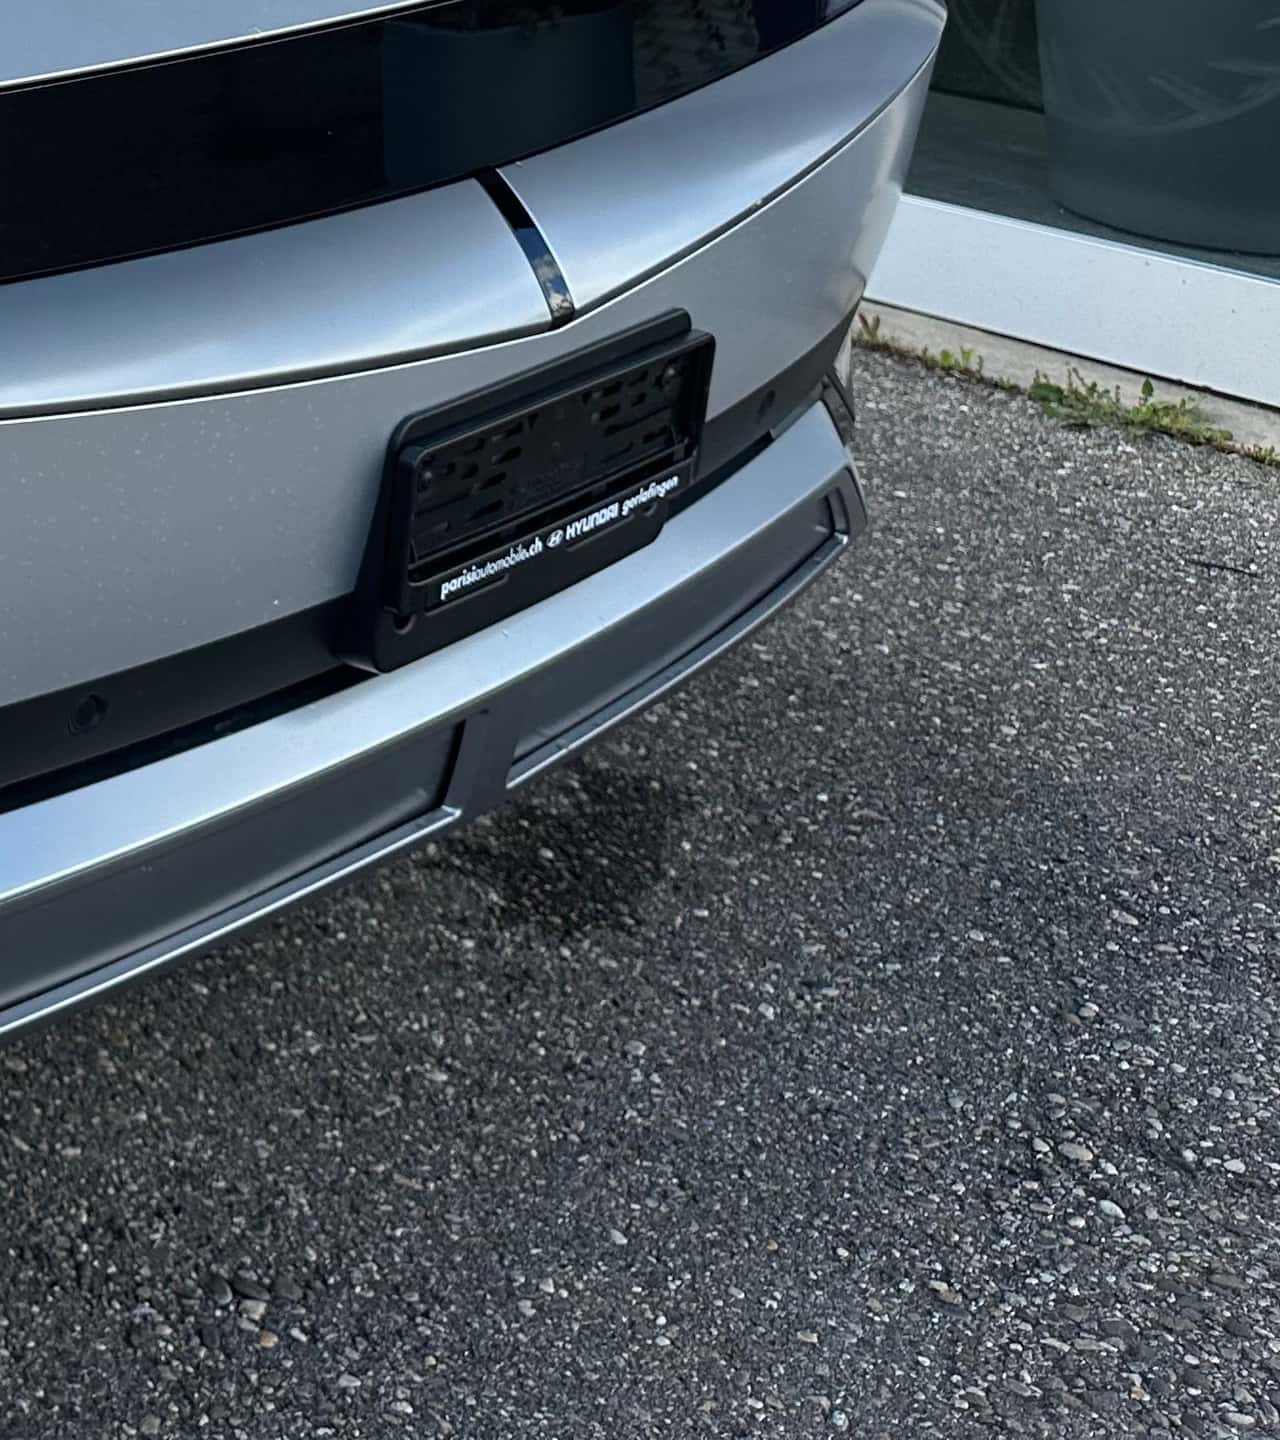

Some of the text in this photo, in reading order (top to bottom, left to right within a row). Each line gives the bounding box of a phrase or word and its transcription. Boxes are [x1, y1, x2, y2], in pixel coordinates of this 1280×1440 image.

[440, 475, 679, 601] parisiautomobile.ch HYUNDAI gerlafingen
